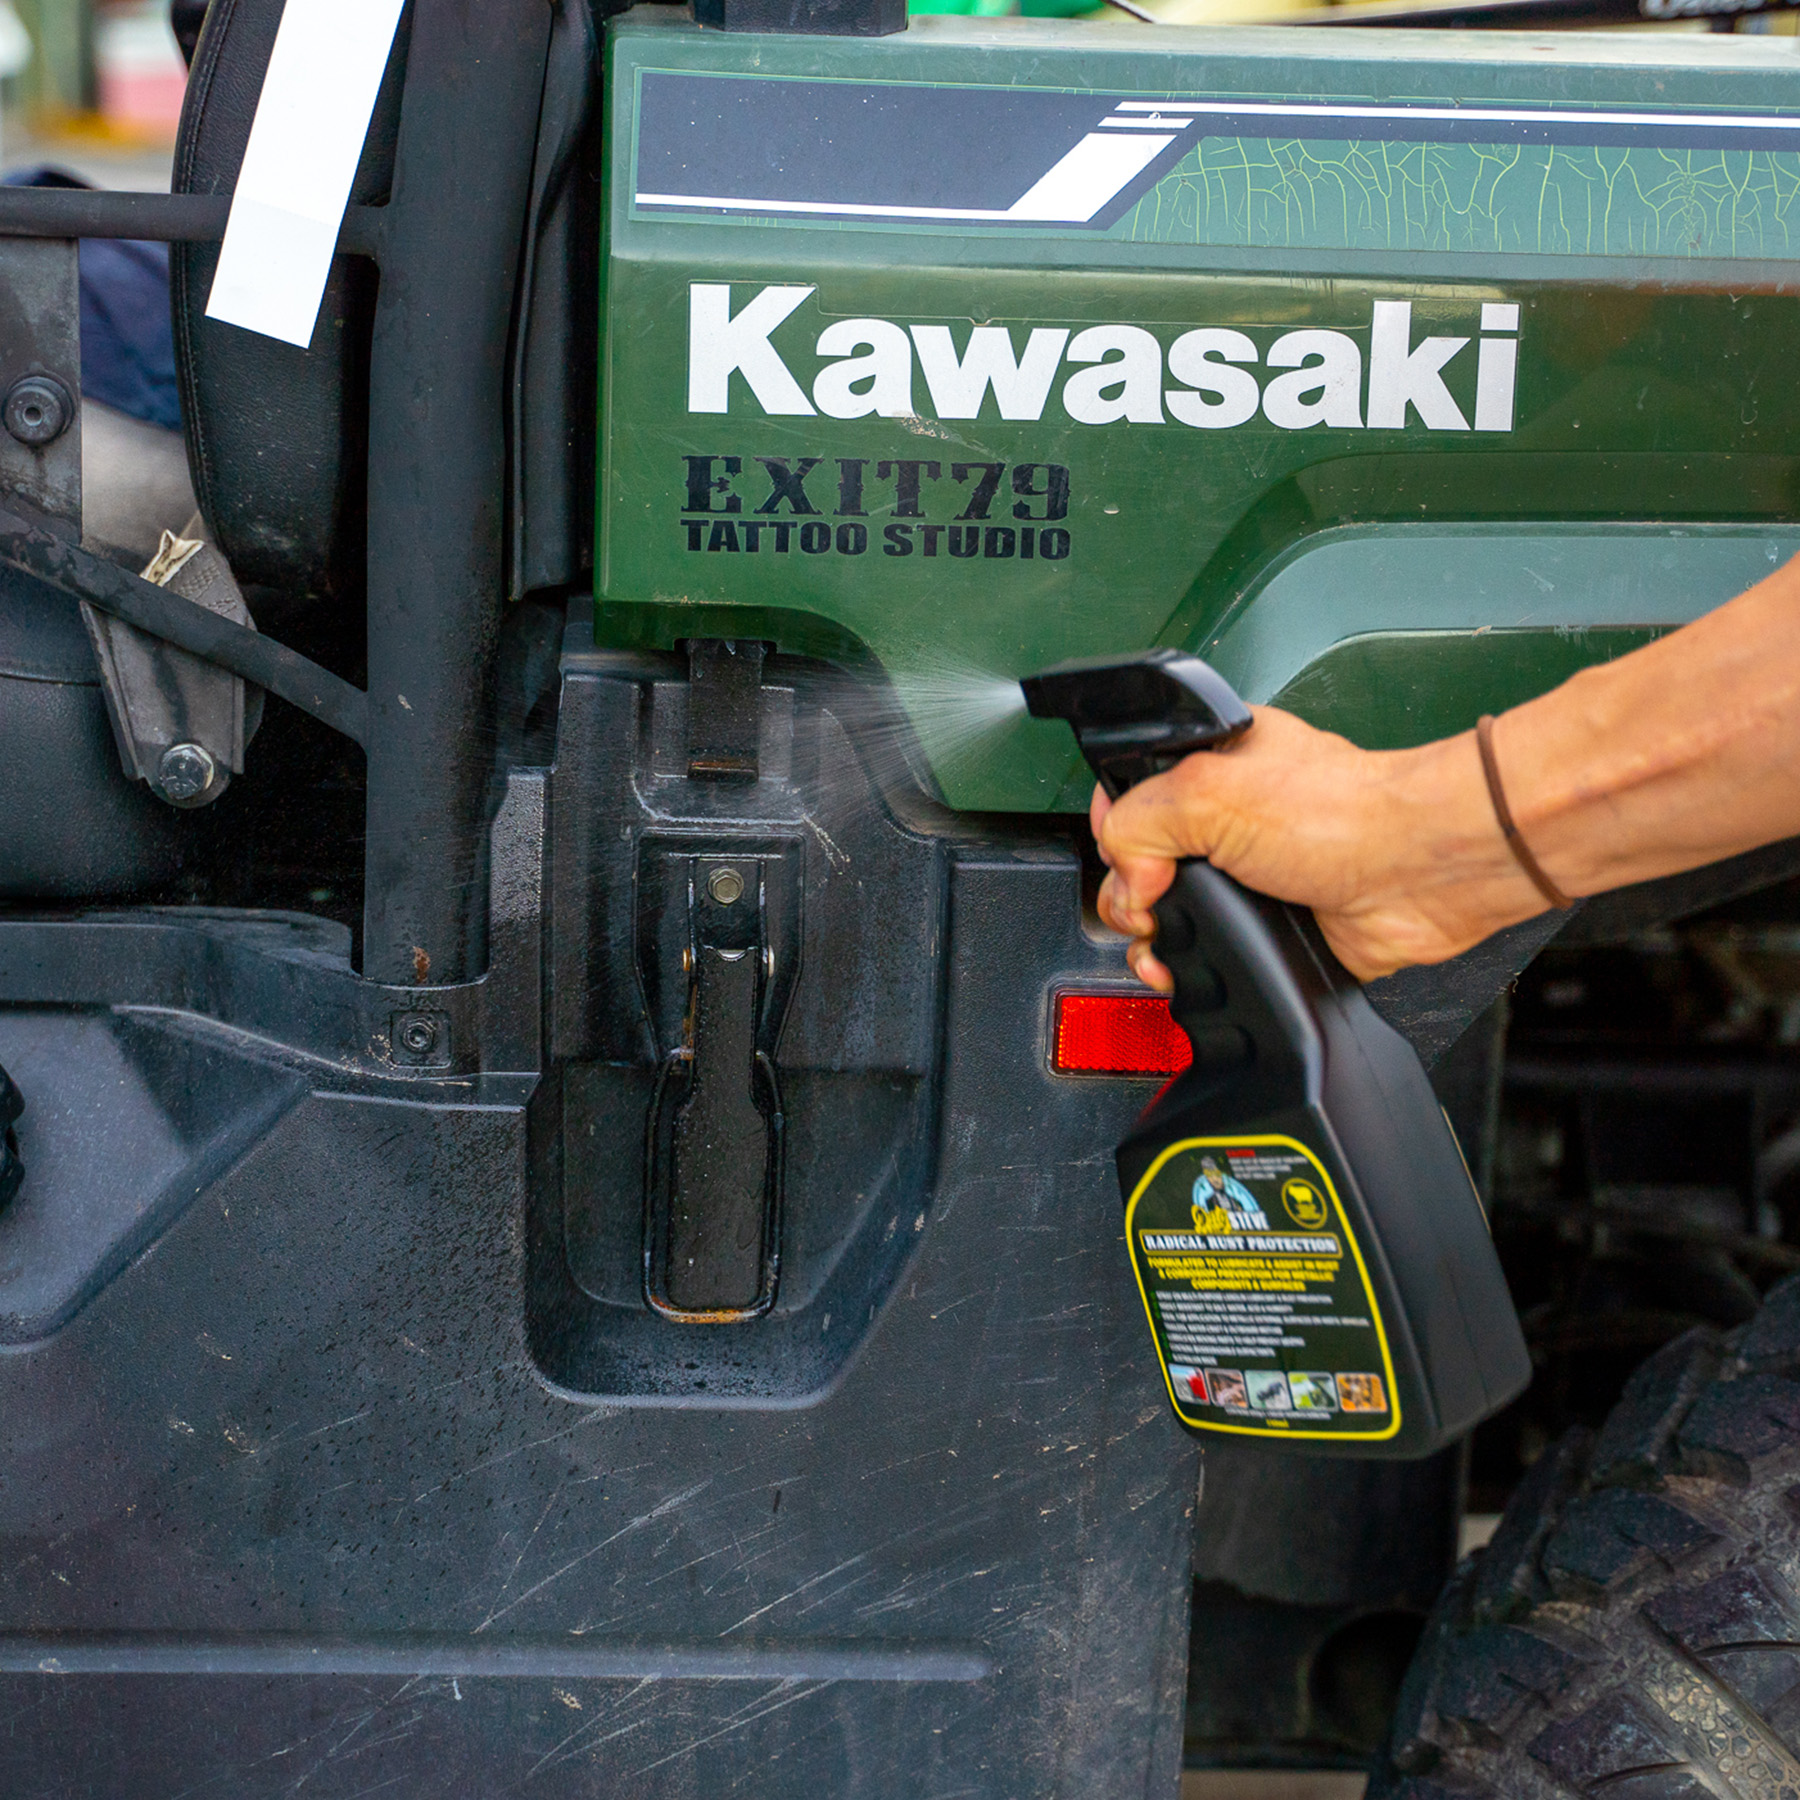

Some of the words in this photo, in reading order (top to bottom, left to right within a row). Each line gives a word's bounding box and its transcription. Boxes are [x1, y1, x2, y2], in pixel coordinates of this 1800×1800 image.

[688, 282, 1521, 433] Kawasaki
[680, 454, 1071, 521] EXIT79
[680, 518, 868, 556] TATTOO
[882, 523, 1072, 560] STUDIO
[1144, 1234, 1207, 1251] RADICAL
[1205, 1236, 1246, 1251] RUST
[1246, 1237, 1339, 1254] PROTECTION
